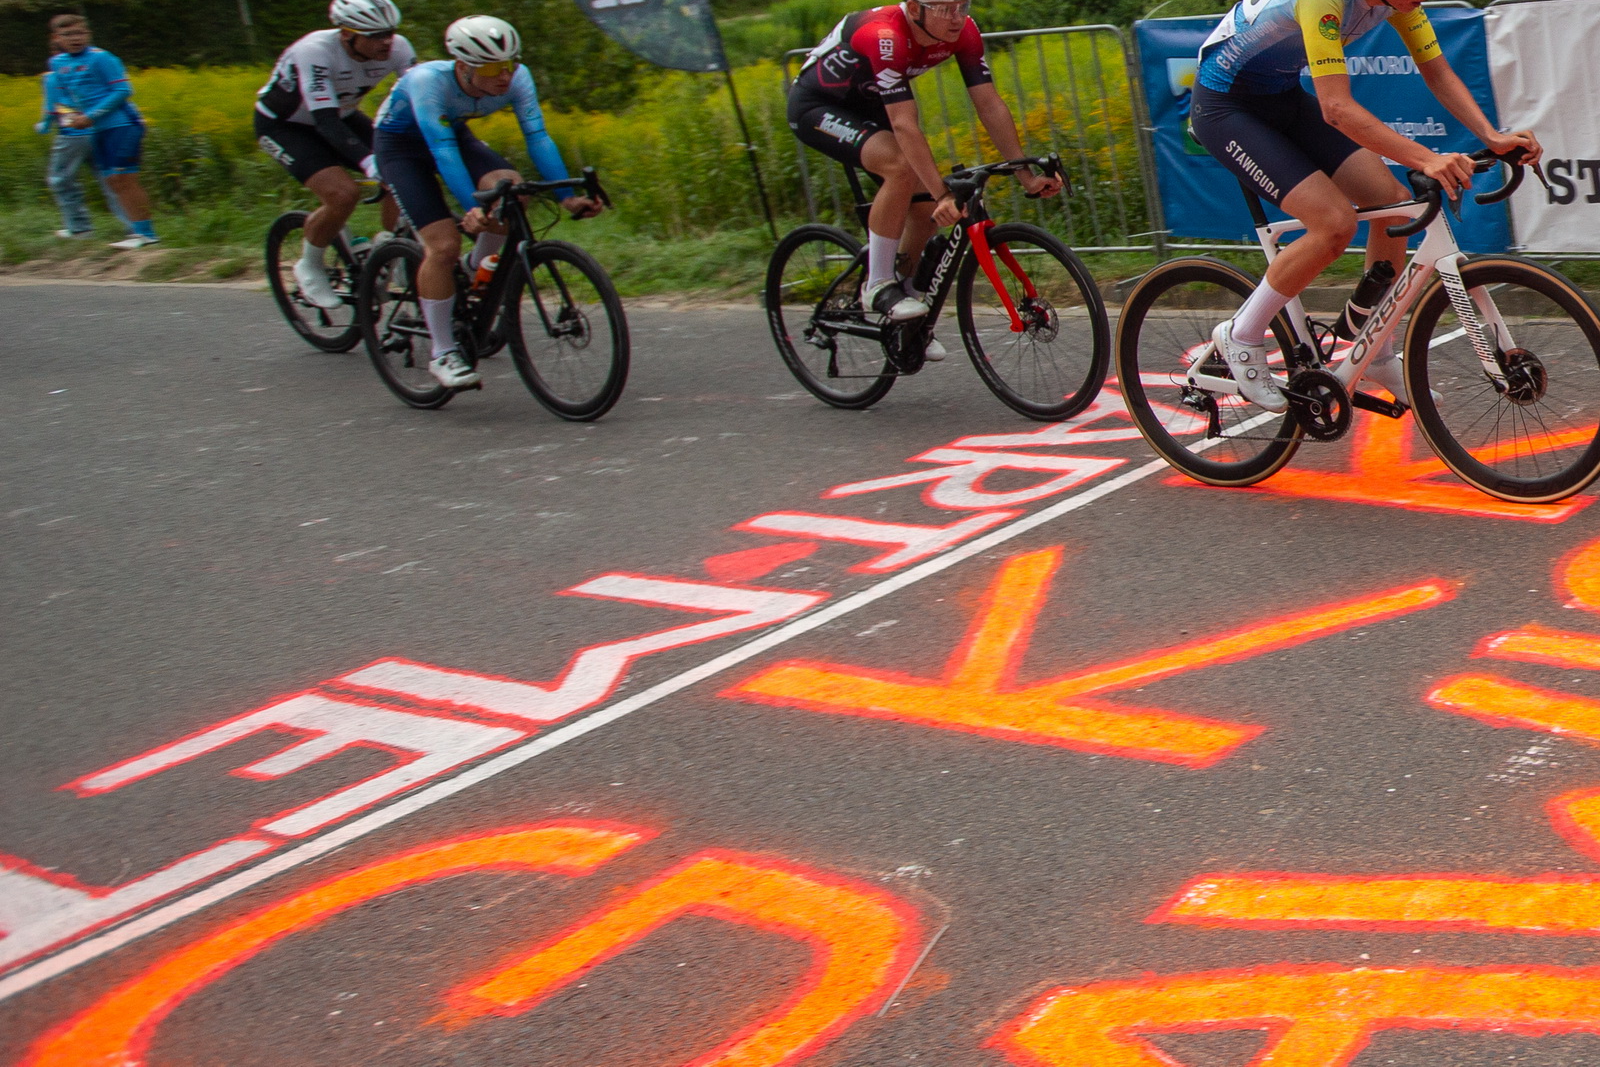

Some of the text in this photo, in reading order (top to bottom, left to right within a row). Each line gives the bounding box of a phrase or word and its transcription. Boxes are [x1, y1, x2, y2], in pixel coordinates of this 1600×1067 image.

[822, 49, 859, 79] FTC
[1215, 39, 1243, 71] GKK
[1225, 140, 1280, 200] STAWIGUDA
[1350, 262, 1426, 366] ORBEA
